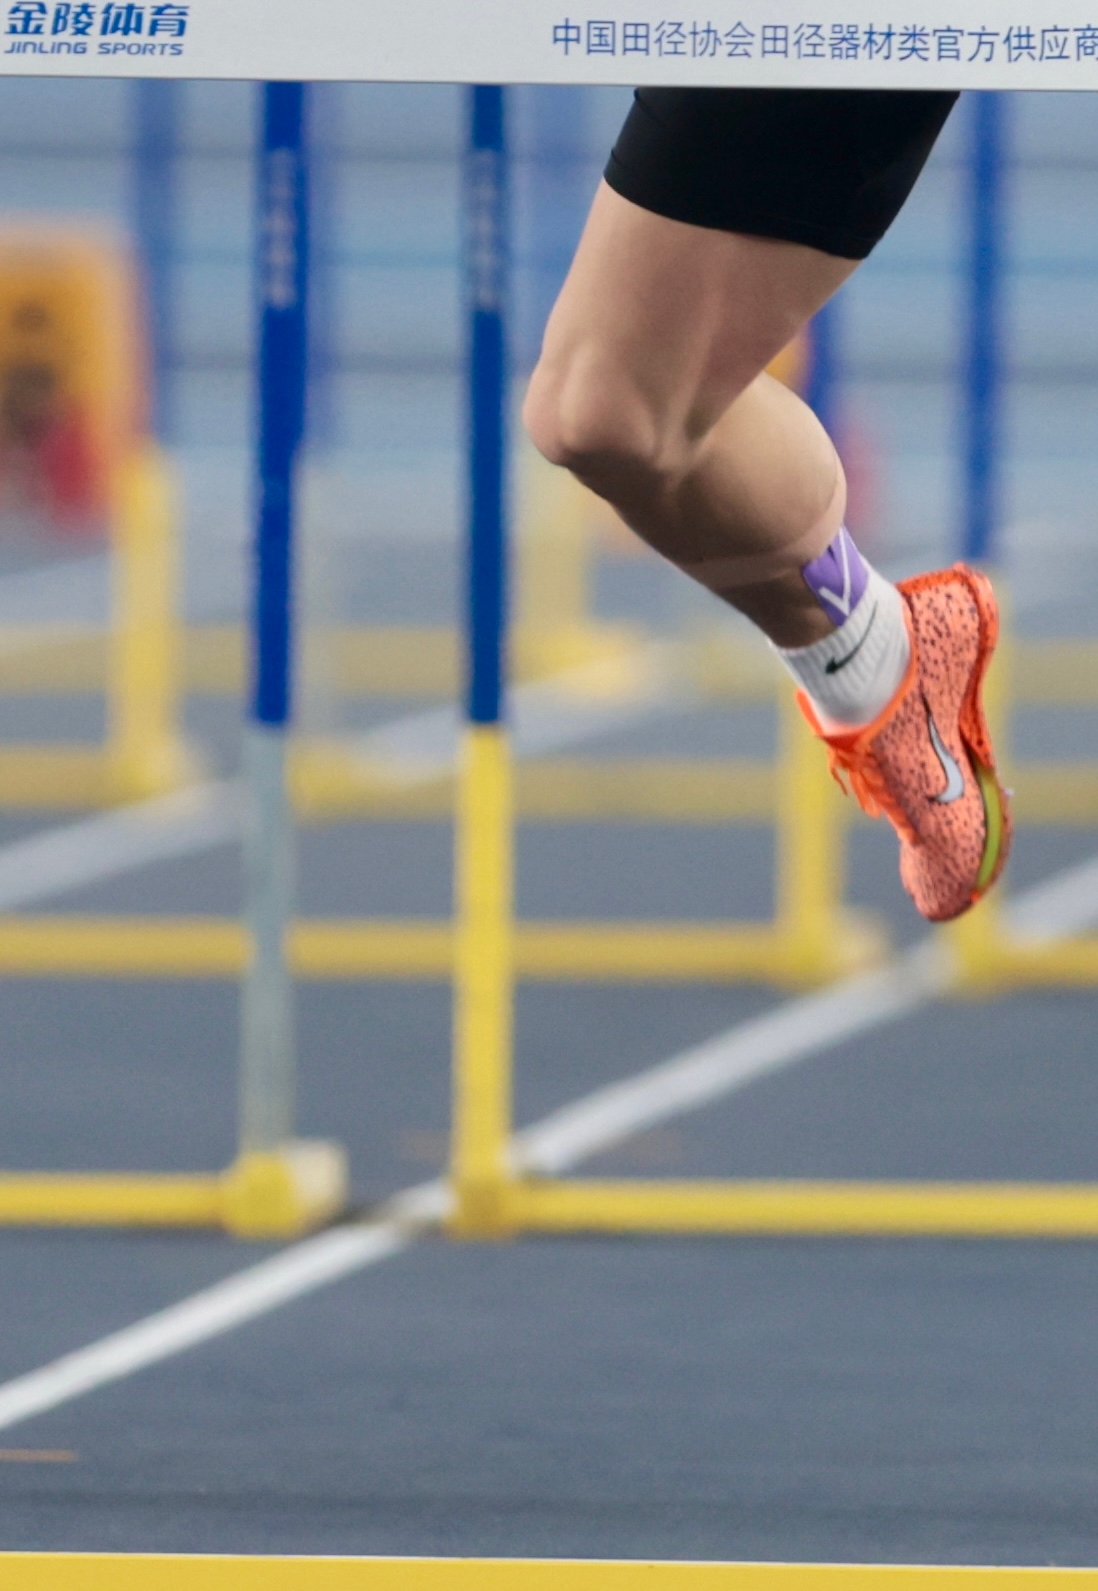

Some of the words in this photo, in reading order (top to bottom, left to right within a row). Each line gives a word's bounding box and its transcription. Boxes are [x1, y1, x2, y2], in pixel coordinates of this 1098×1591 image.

[4, 0, 190, 38] 金陵体育
[4, 41, 88, 55] JINLING
[97, 42, 184, 57] SPORTS
